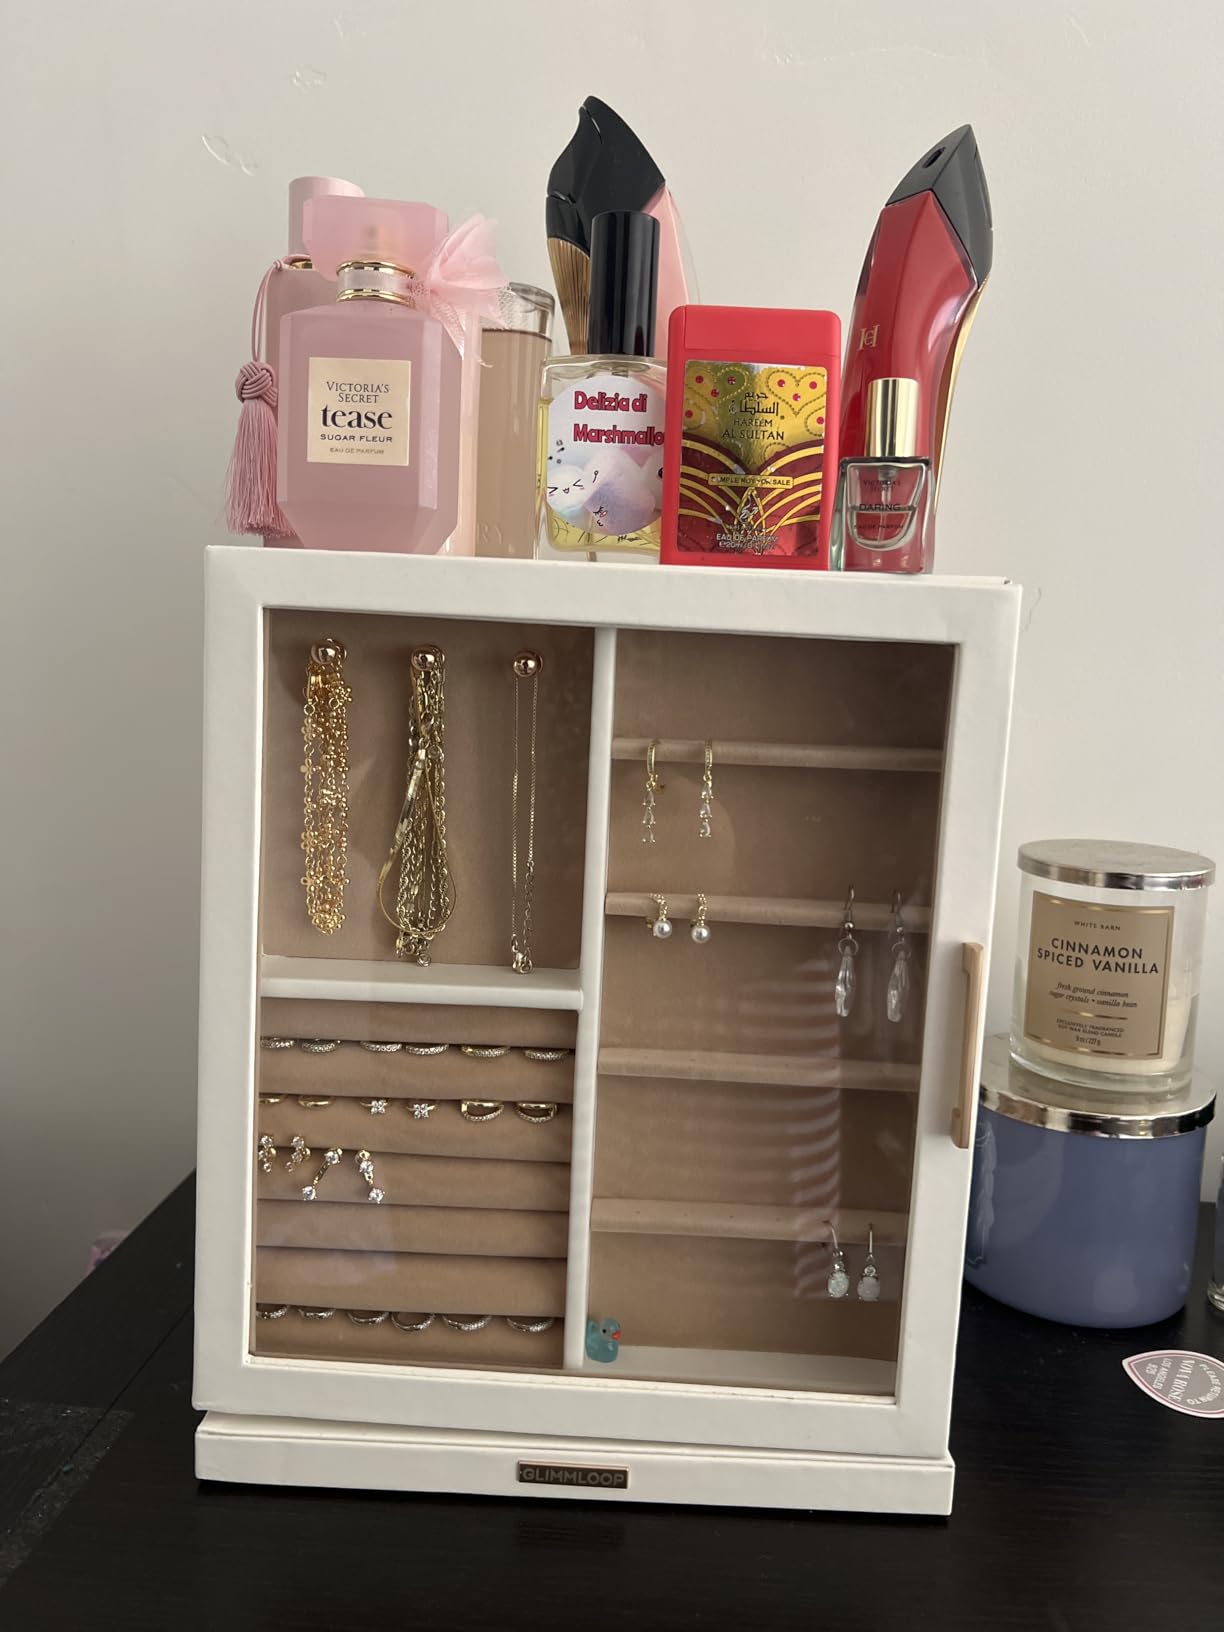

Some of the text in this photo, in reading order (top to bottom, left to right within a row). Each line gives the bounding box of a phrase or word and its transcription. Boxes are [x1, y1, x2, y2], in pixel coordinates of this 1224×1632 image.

[326, 381, 390, 393] VICTORIA'S
[338, 392, 379, 403] SECRET
[574, 391, 648, 413] Delizia di
[321, 404, 393, 429] tease
[733, 419, 773, 428] HAREEM
[320, 433, 393, 443] SUGAR FLEUR
[722, 430, 784, 441] AL SULTAN
[859, 503, 900, 512] DARING
[1074, 920, 1121, 931] WHITE BARN
[1051, 937, 1143, 959] CINNAMON
[1037, 948, 1159, 974] SPICED VANILLA
[1072, 986, 1096, 995] ground
[1167, 1378, 1189, 1402] ROSE
[522, 1467, 625, 1486] GLIMMLOOP
